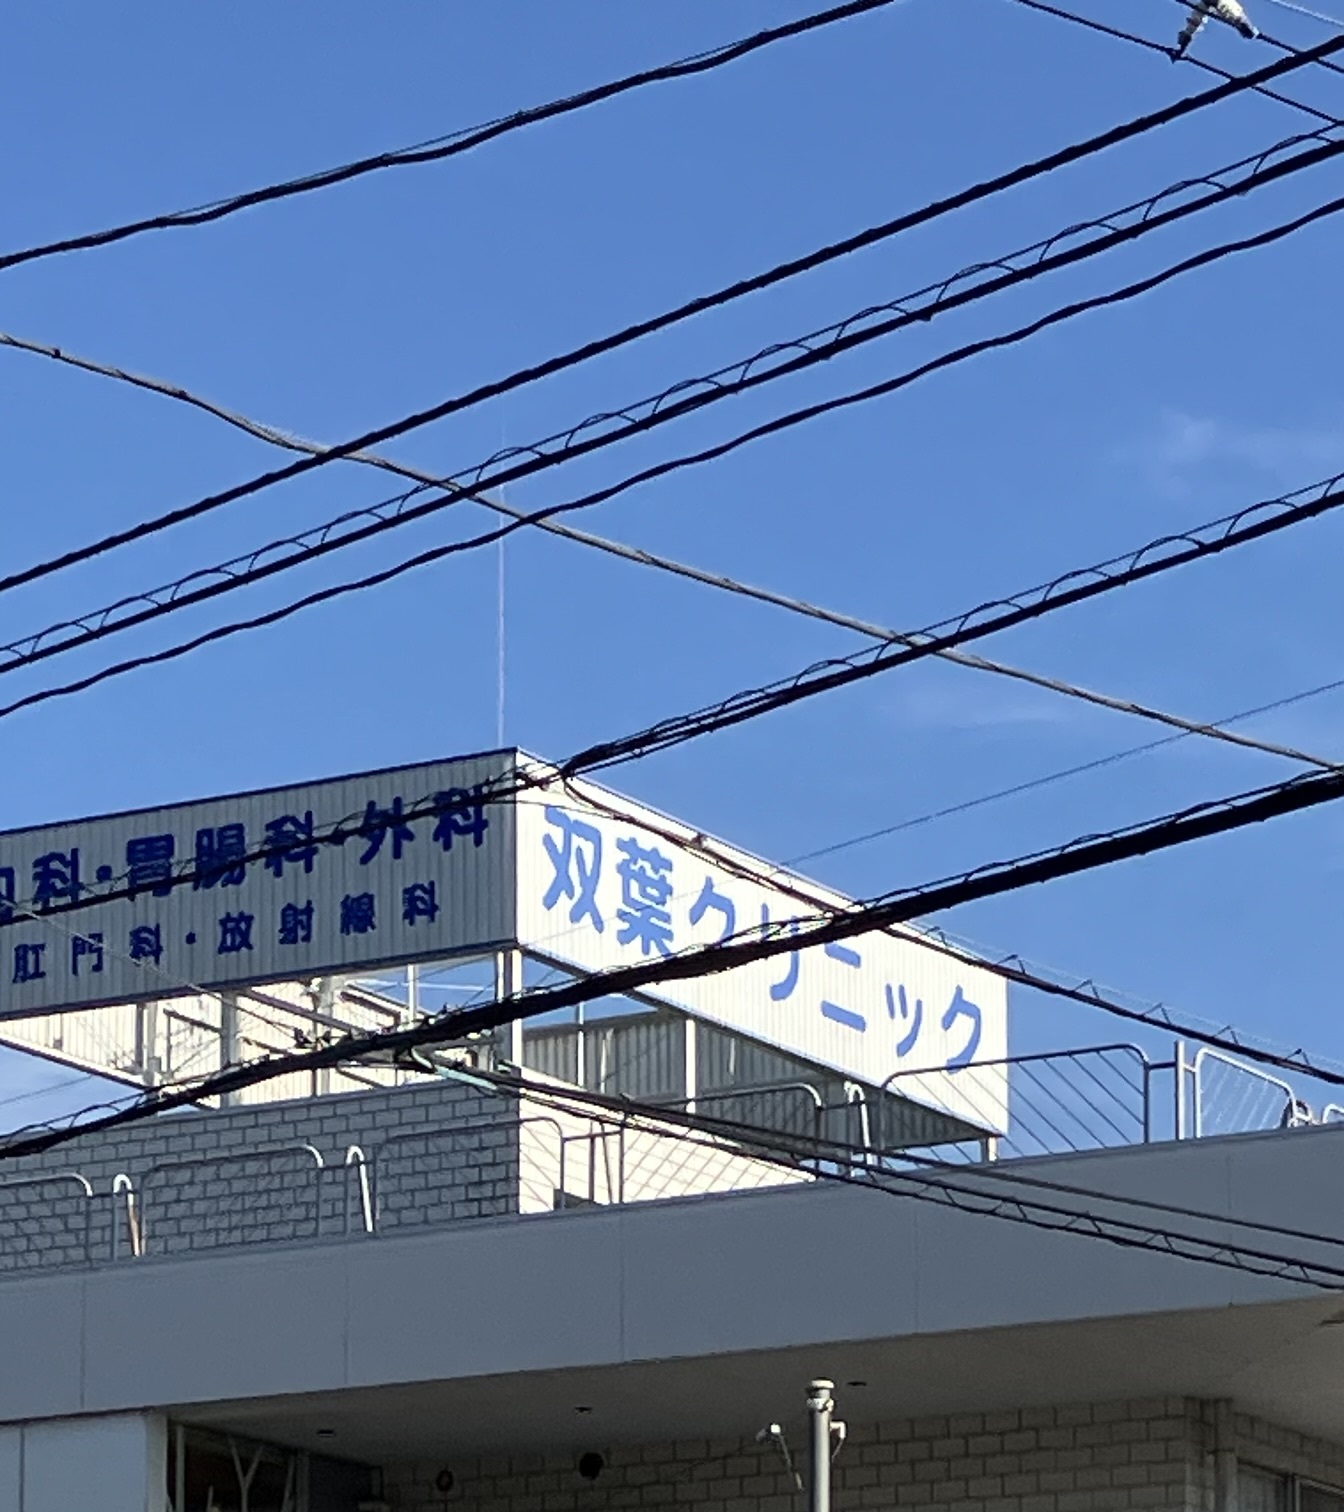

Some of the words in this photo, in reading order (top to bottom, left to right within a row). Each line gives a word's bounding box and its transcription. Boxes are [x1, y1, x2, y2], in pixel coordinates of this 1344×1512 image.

[13, 880, 439, 983] 肛門科・放射線科
[542, 805, 982, 1075] 双葉クリニック
